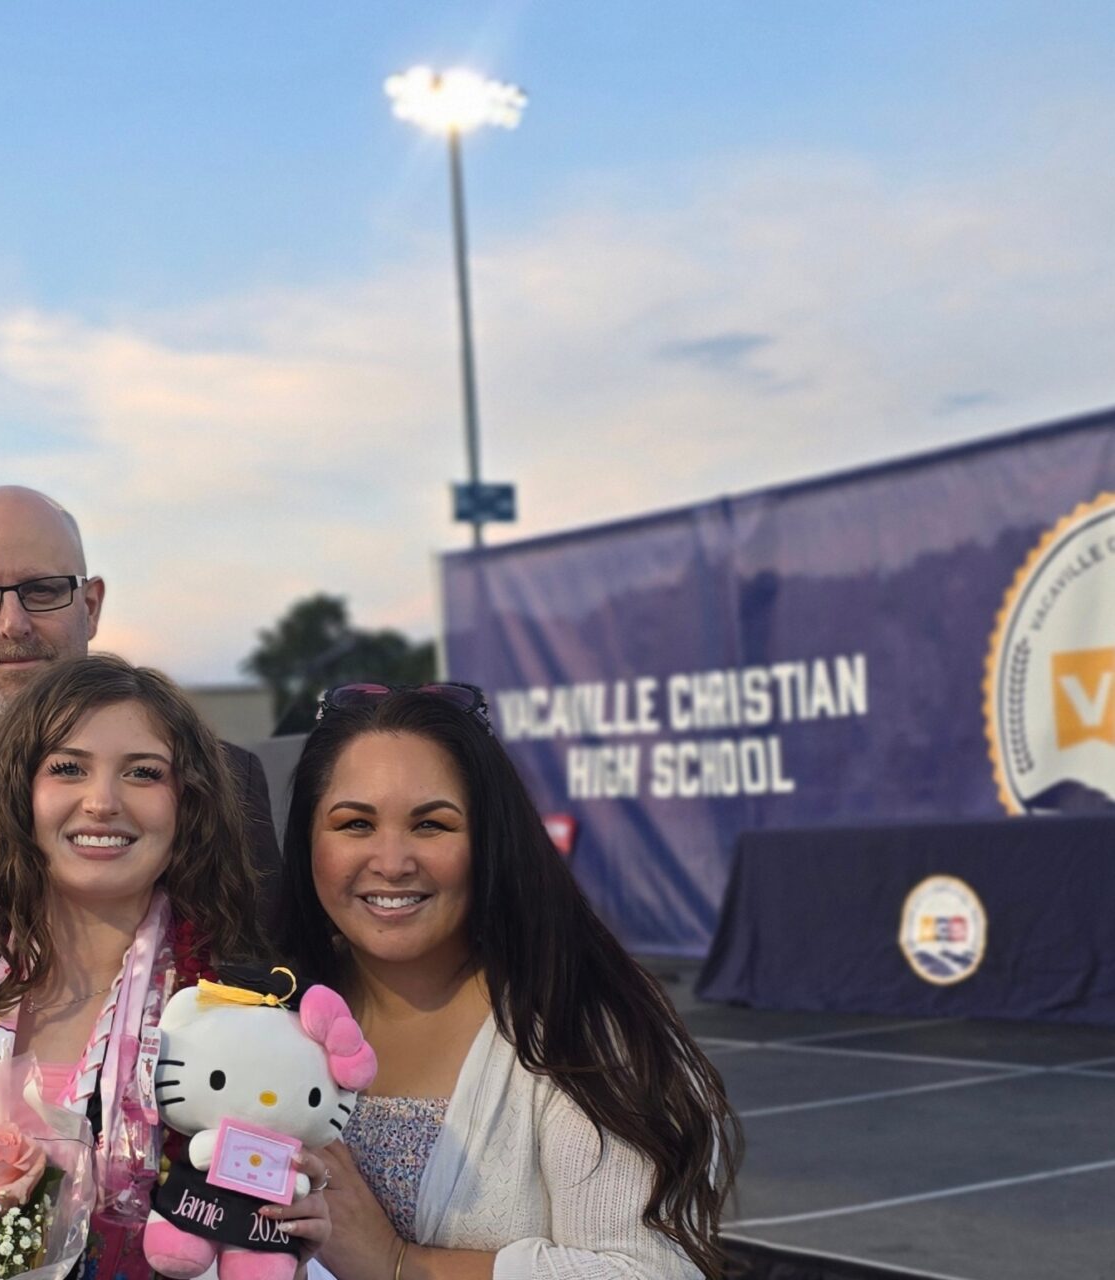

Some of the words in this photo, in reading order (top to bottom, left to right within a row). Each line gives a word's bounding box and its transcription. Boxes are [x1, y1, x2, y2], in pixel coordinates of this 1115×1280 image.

[668, 655, 867, 731] CHRISTIAN
[568, 745, 640, 800] HIGH
[651, 736, 795, 798] SCHOOL
[172, 1189, 224, 1230] Jamie
